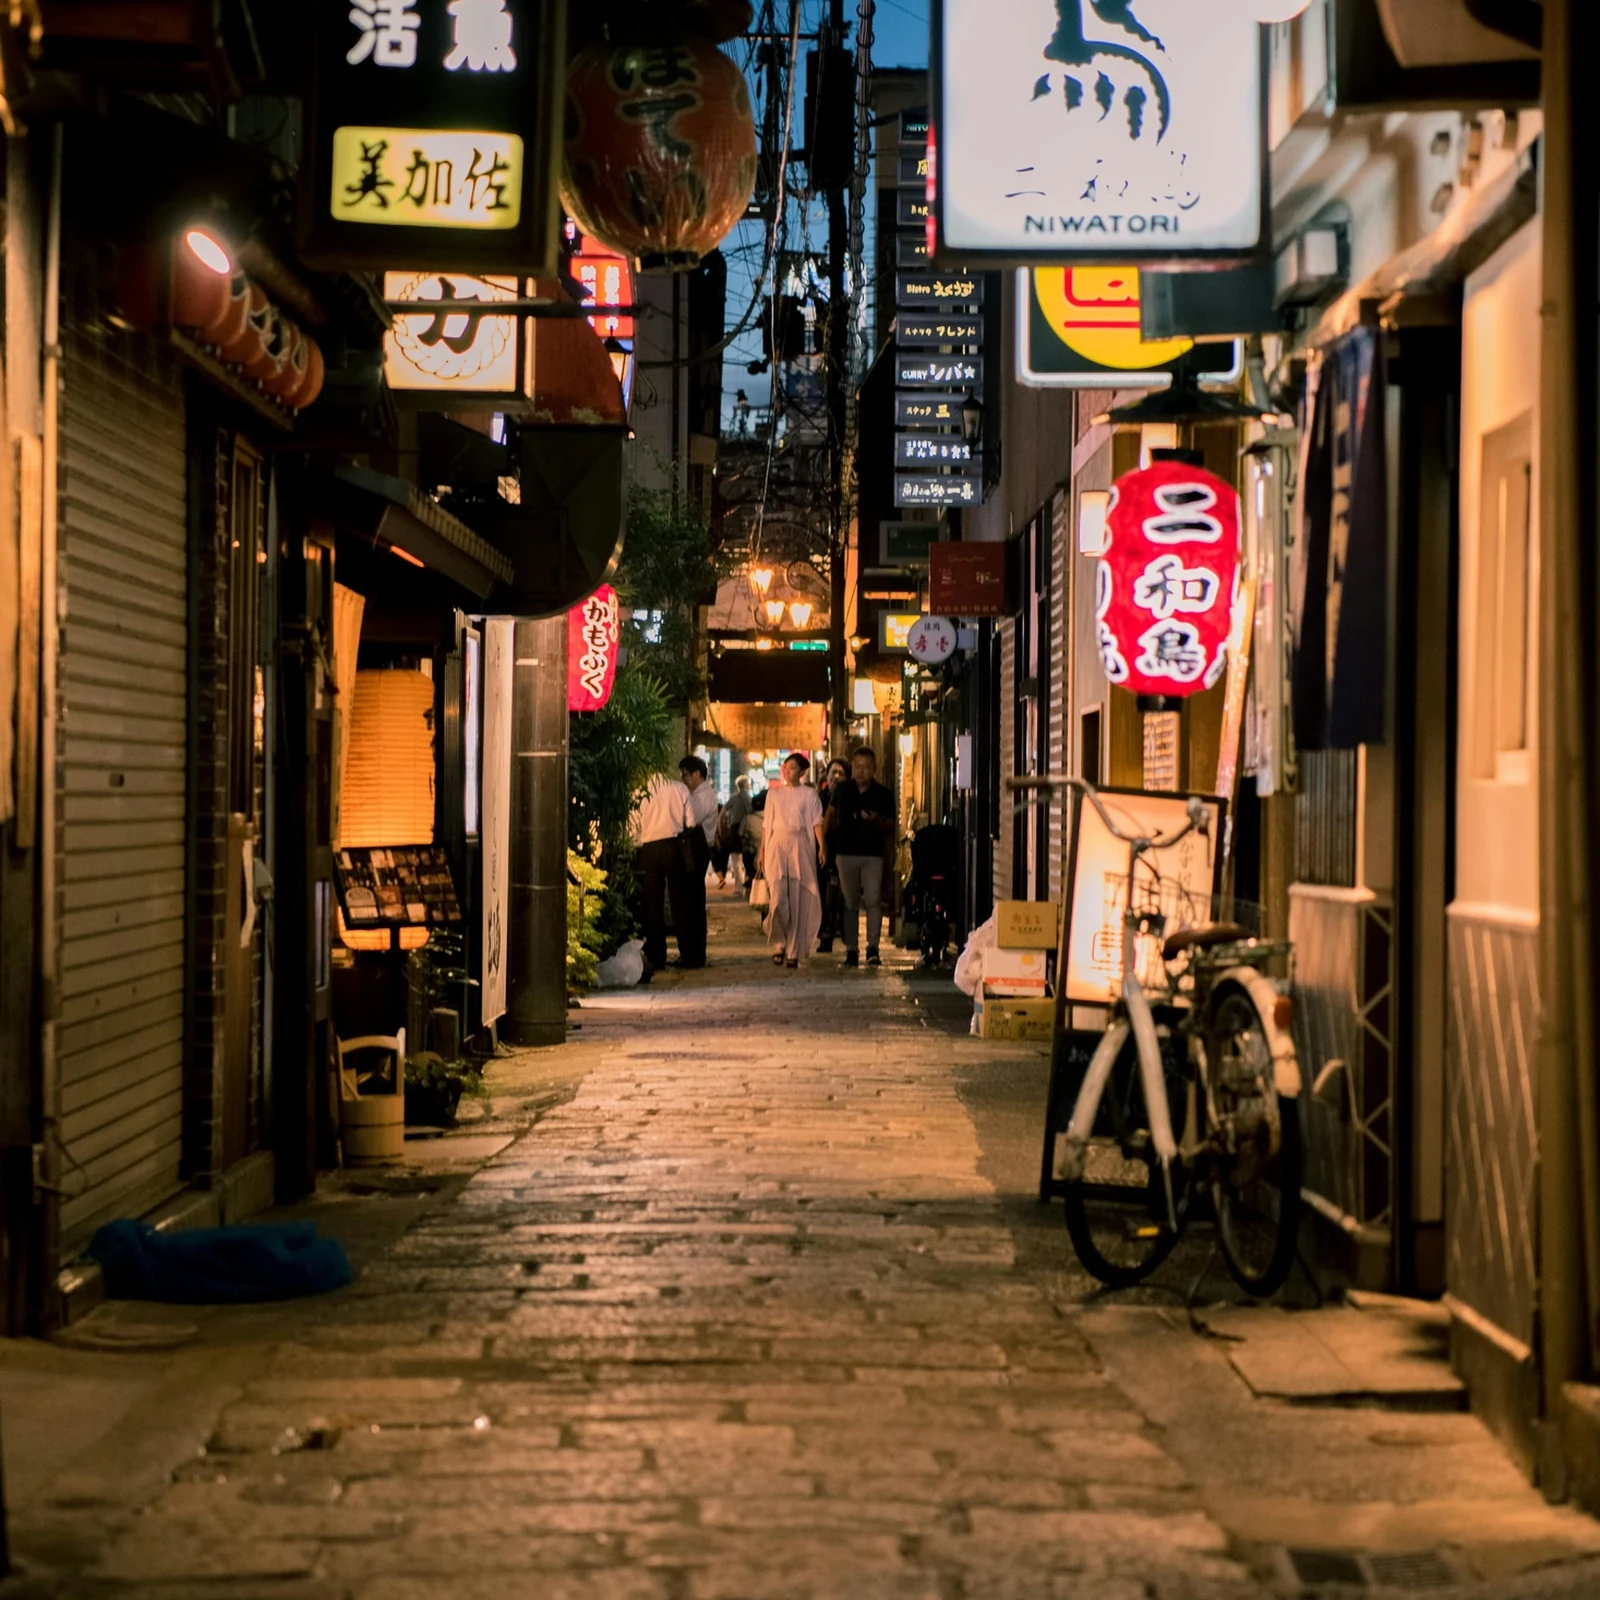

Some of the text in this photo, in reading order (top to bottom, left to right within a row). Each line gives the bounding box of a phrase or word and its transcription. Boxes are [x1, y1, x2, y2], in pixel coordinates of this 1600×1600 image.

[344, 139, 511, 209] 美加佐
[1023, 214, 1181, 234] NIWATORI
[906, 284, 931, 294] Bistro
[904, 325, 976, 337] スナック フレンド
[902, 369, 928, 380] CURRY
[906, 406, 932, 416] スナック
[1133, 482, 1222, 683] 二和鳥
[580, 596, 610, 699] かもふく
